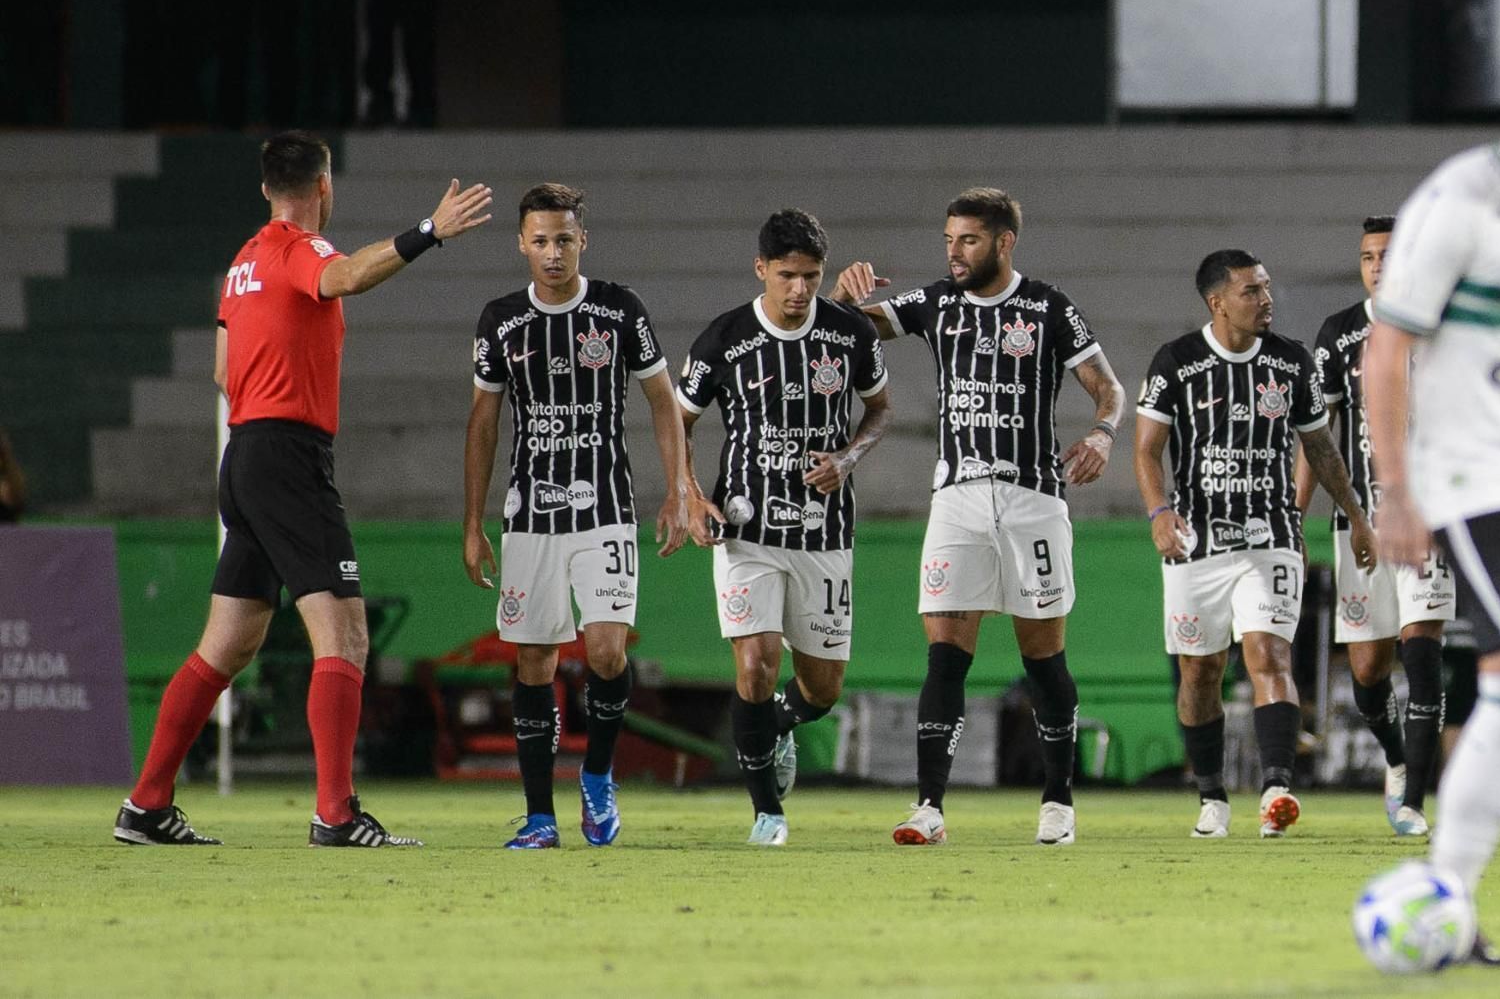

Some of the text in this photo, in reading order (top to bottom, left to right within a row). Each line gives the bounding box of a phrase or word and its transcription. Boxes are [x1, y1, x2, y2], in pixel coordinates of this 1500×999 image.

[225, 260, 262, 298] TCL
[578, 302, 626, 323] pixbet
[1005, 296, 1049, 313] pixbet
[497, 308, 538, 340] pixbet
[1068, 315, 1089, 349] bmg
[637, 325, 656, 362] bmg
[724, 331, 769, 363] pixbet
[810, 328, 856, 349] pixbet
[691, 360, 712, 390] bmg
[1177, 353, 1220, 382] pixbet
[1257, 354, 1301, 376] pixbet
[950, 378, 1026, 395] vitaminas
[1150, 374, 1169, 404] bmg
[526, 402, 602, 416] vitaminas
[948, 393, 985, 409] neo
[1310, 382, 1324, 415] bmg
[527, 418, 565, 433] neo
[759, 424, 834, 439] vitaminas
[758, 439, 799, 454] neo
[1202, 447, 1277, 460] vitaminas
[1201, 460, 1240, 475] neo
[538, 489, 566, 504] Tele
[771, 507, 800, 521] Tele
[1215, 527, 1244, 542] Tele
[602, 540, 636, 577] 30
[1032, 539, 1052, 576] 9
[823, 578, 850, 616] 14
[15, 683, 89, 712] BRASIL
[513, 717, 550, 729] SCCP
[917, 721, 951, 731] SCCP
